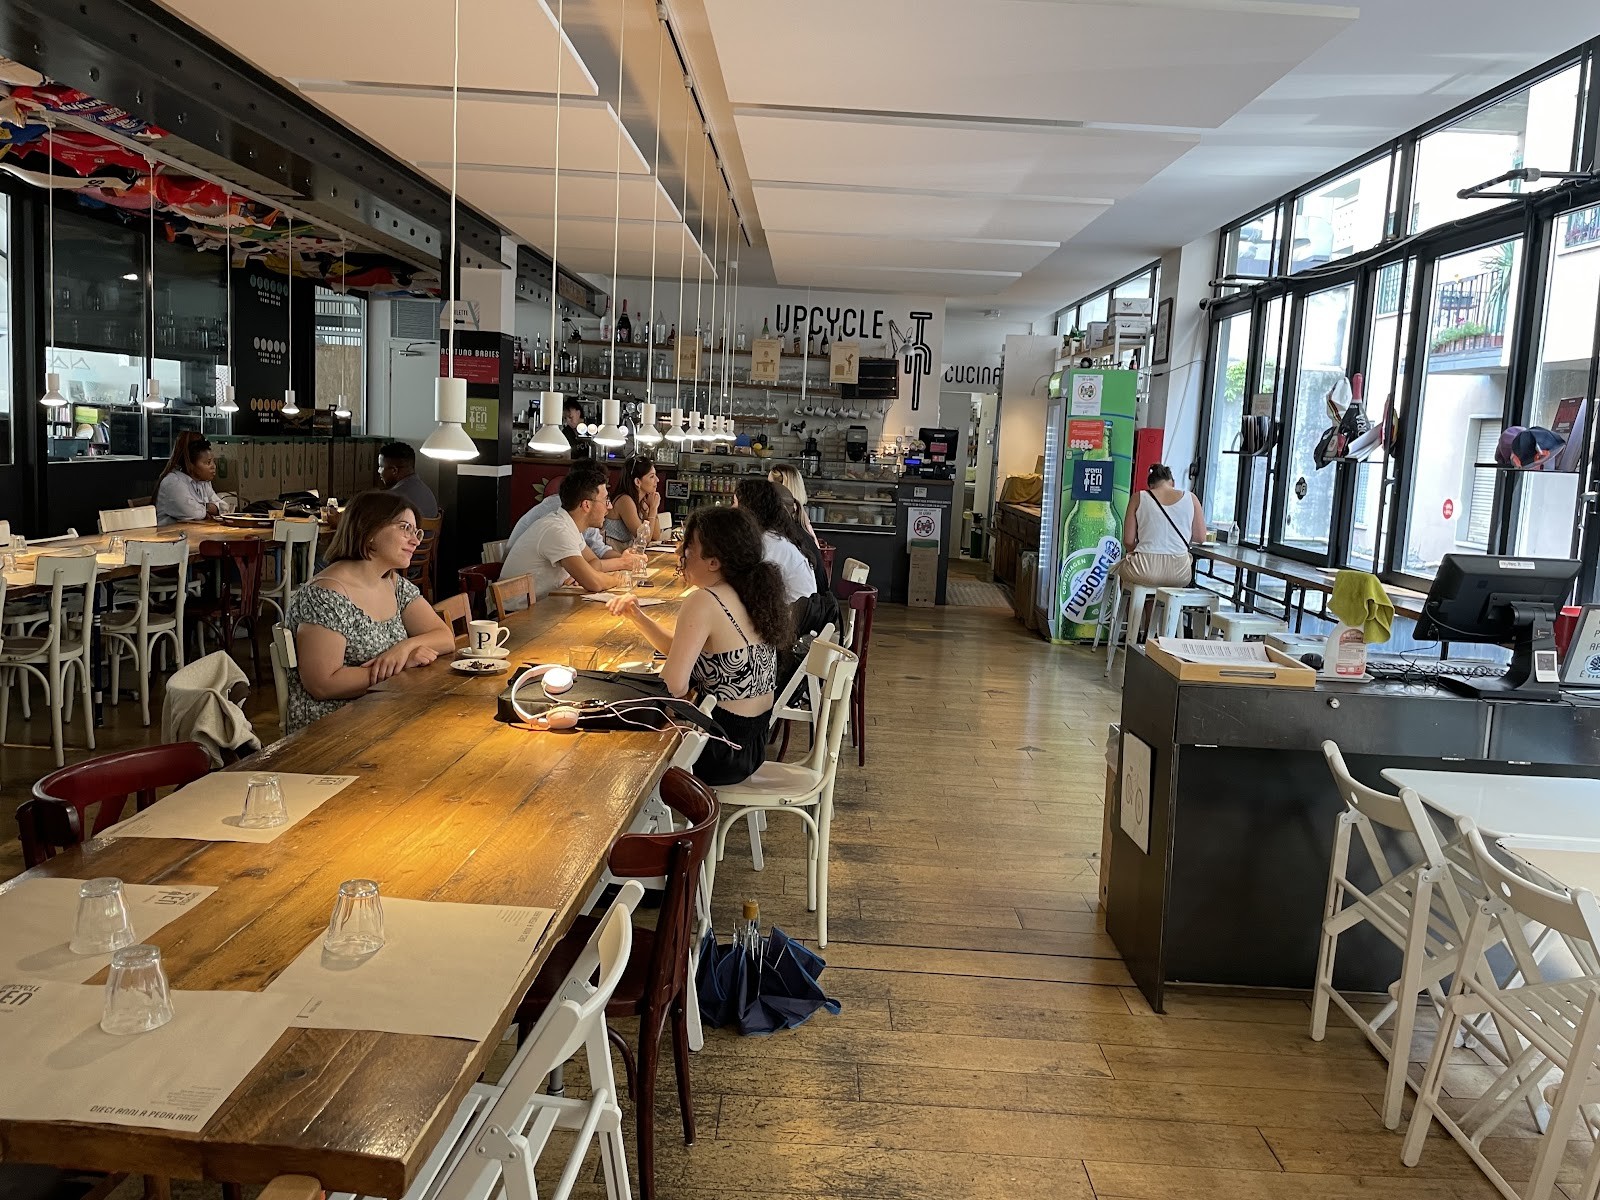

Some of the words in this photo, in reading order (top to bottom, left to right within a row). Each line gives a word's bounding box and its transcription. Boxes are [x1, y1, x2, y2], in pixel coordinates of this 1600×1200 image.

[776, 304, 884, 339] UPCYCLE
[440, 347, 473, 357] ACTUNG
[474, 349, 500, 358] BABIES
[944, 365, 1000, 385] CUCINA
[1062, 558, 1086, 595] COPENHAGEN
[1064, 554, 1113, 617] TUBORG
[477, 631, 491, 650] P
[89, 1105, 116, 1113] DIECI
[115, 1108, 139, 1116] ANNI
[139, 1110, 148, 1118] A
